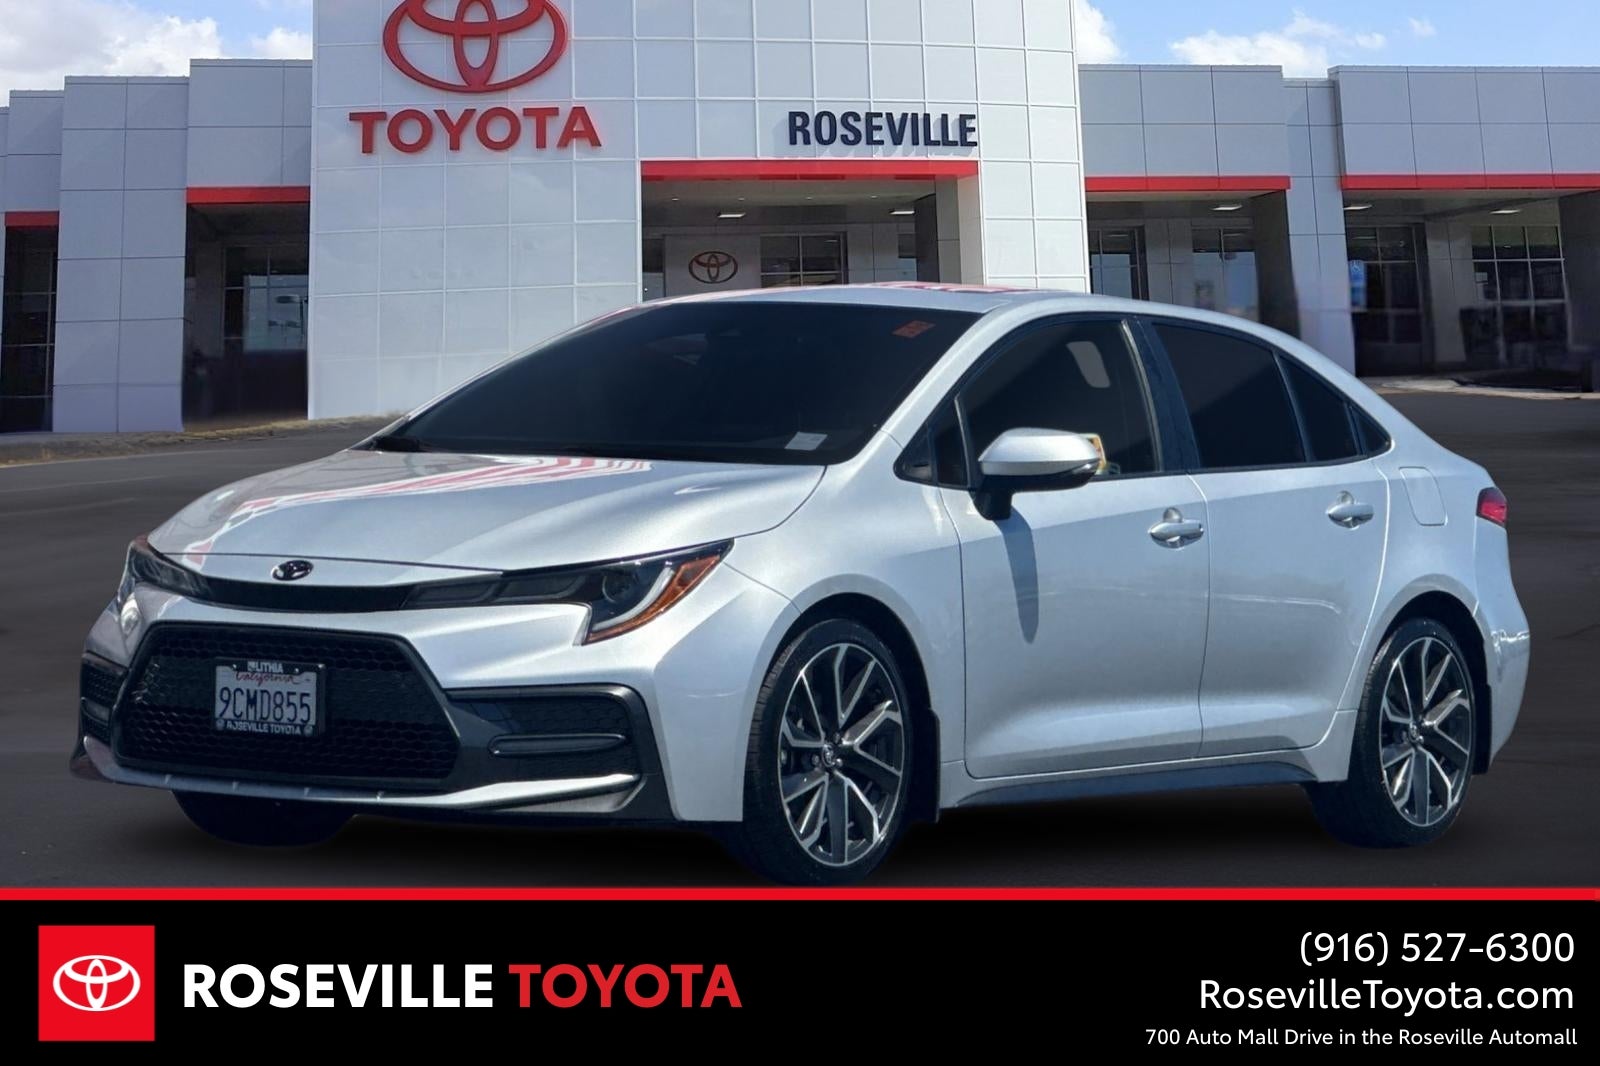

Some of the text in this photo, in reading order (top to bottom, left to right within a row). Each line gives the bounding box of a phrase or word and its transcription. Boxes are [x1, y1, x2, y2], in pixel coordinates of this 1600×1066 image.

[350, 106, 602, 154] TOYOTA
[788, 110, 978, 147] ROSEVILLE
[219, 686, 311, 724] 9CMD855
[270, 724, 301, 736] TOYOTA
